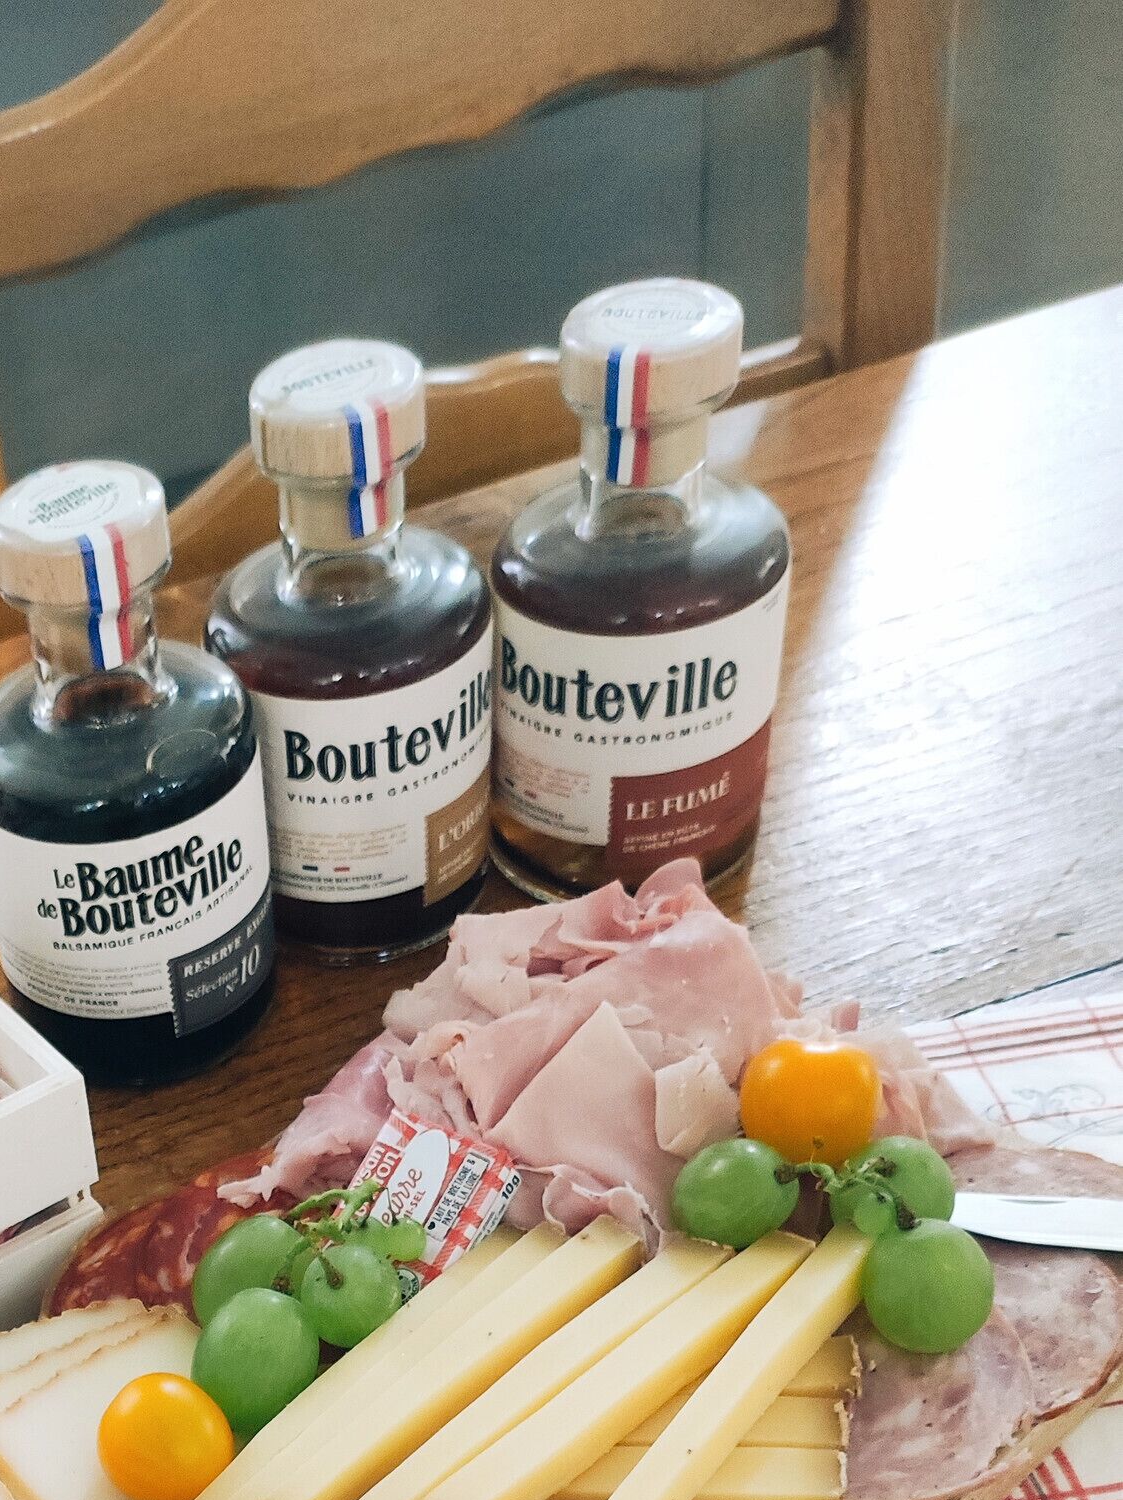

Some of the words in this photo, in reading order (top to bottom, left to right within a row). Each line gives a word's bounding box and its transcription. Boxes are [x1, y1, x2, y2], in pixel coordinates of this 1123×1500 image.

[501, 636, 738, 724] Bouteville
[574, 711, 734, 745] GASTRONOMIQUE
[287, 791, 375, 806] VINAIGRE
[626, 801, 659, 821] LE
[663, 771, 731, 817] FUMÉ
[37, 898, 58, 920] de
[58, 839, 243, 937] Bouteville
[53, 869, 76, 889] Le
[76, 835, 204, 902] Baume
[53, 936, 134, 951] BALSAMIQUE
[206, 864, 254, 912] ARTISANAL
[241, 944, 259, 986] 10
[79, 998, 119, 1008] FRANCE
[381, 1168, 423, 1229] eurre
[433, 1206, 446, 1222] LAIT
[442, 1196, 452, 1206] DE
[448, 1165, 472, 1197] BRETAGNE
[442, 1210, 456, 1226] PAYS
[452, 1200, 462, 1210] DE
[458, 1190, 469, 1200] LA
[466, 1172, 480, 1190] LOIRE
